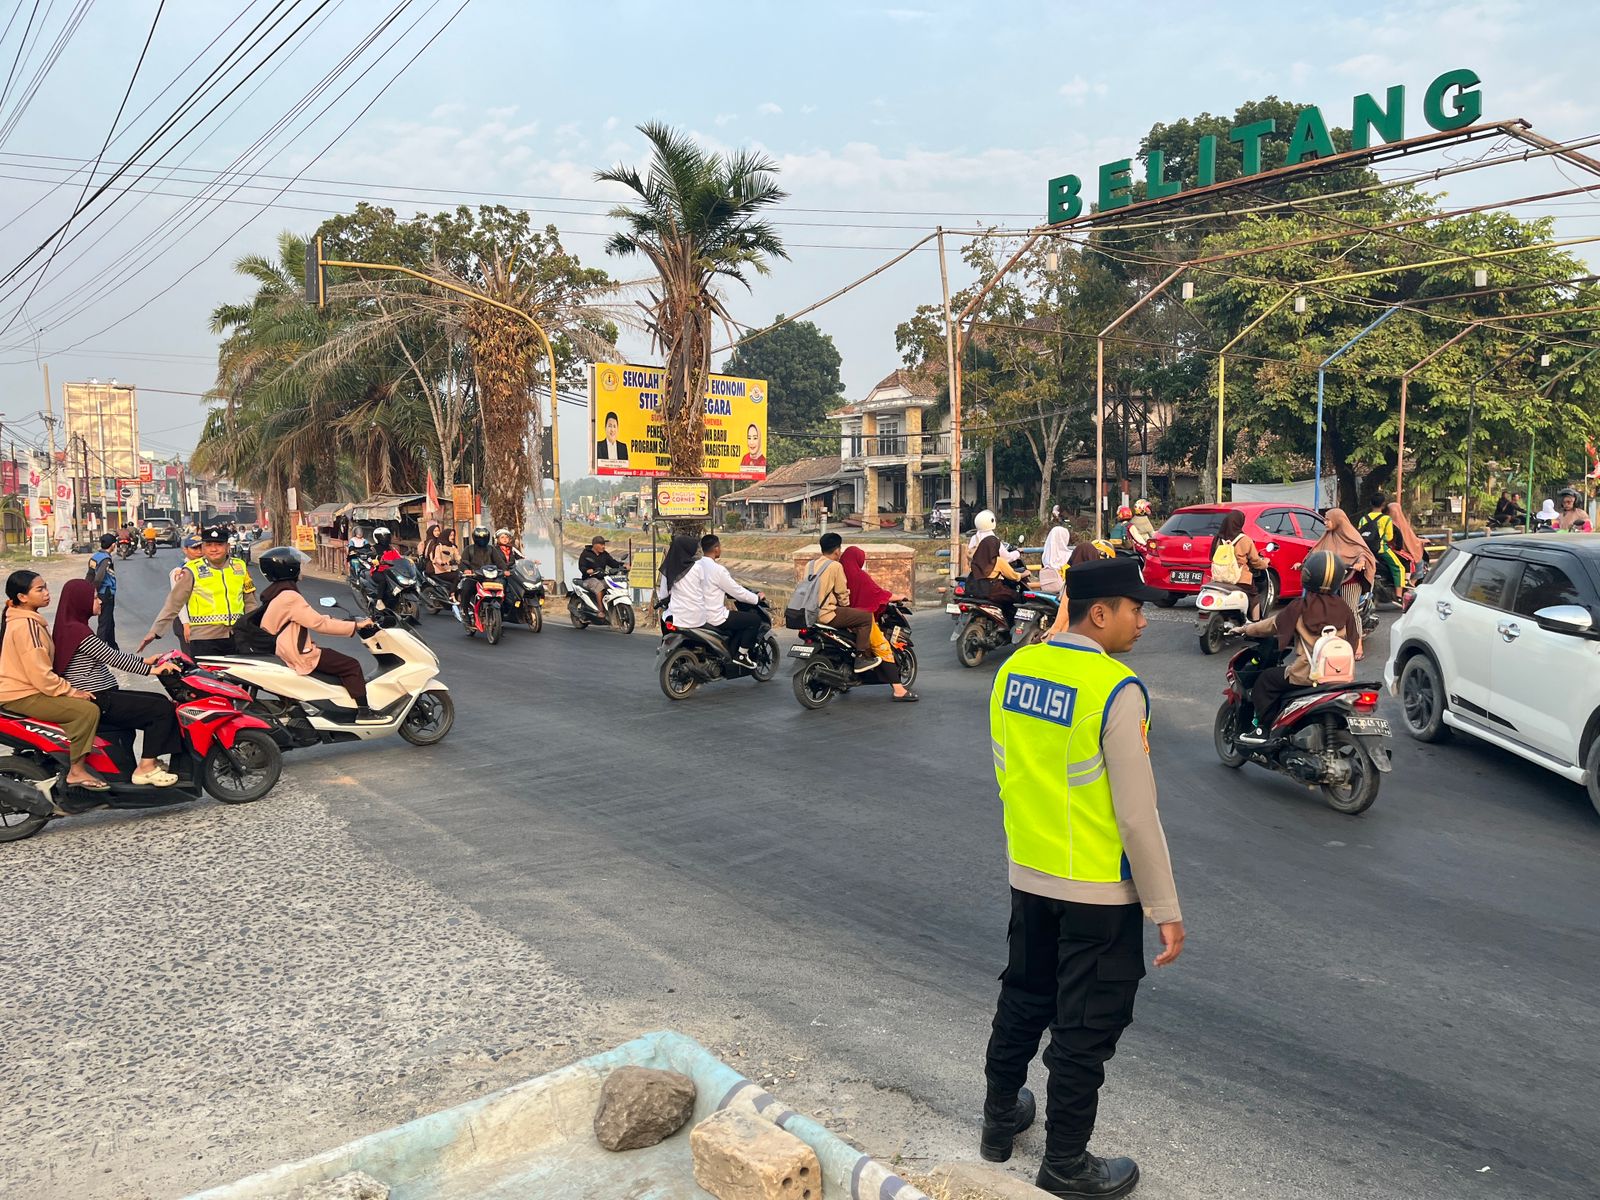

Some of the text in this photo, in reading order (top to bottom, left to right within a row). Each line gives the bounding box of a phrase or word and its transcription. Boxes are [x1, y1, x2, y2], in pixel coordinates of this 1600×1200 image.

[1048, 68, 1482, 225] BELITANG
[623, 371, 659, 389] SEKOLAH
[711, 380, 745, 396] EKONOMI
[639, 392, 659, 410] STIE
[704, 398, 731, 415] EGARA
[714, 430, 727, 442] BARU
[631, 440, 658, 453] PROGRAM
[704, 443, 729, 457] MAGISTER
[1006, 680, 1071, 720] POLISI
[25, 725, 72, 743] VAR
